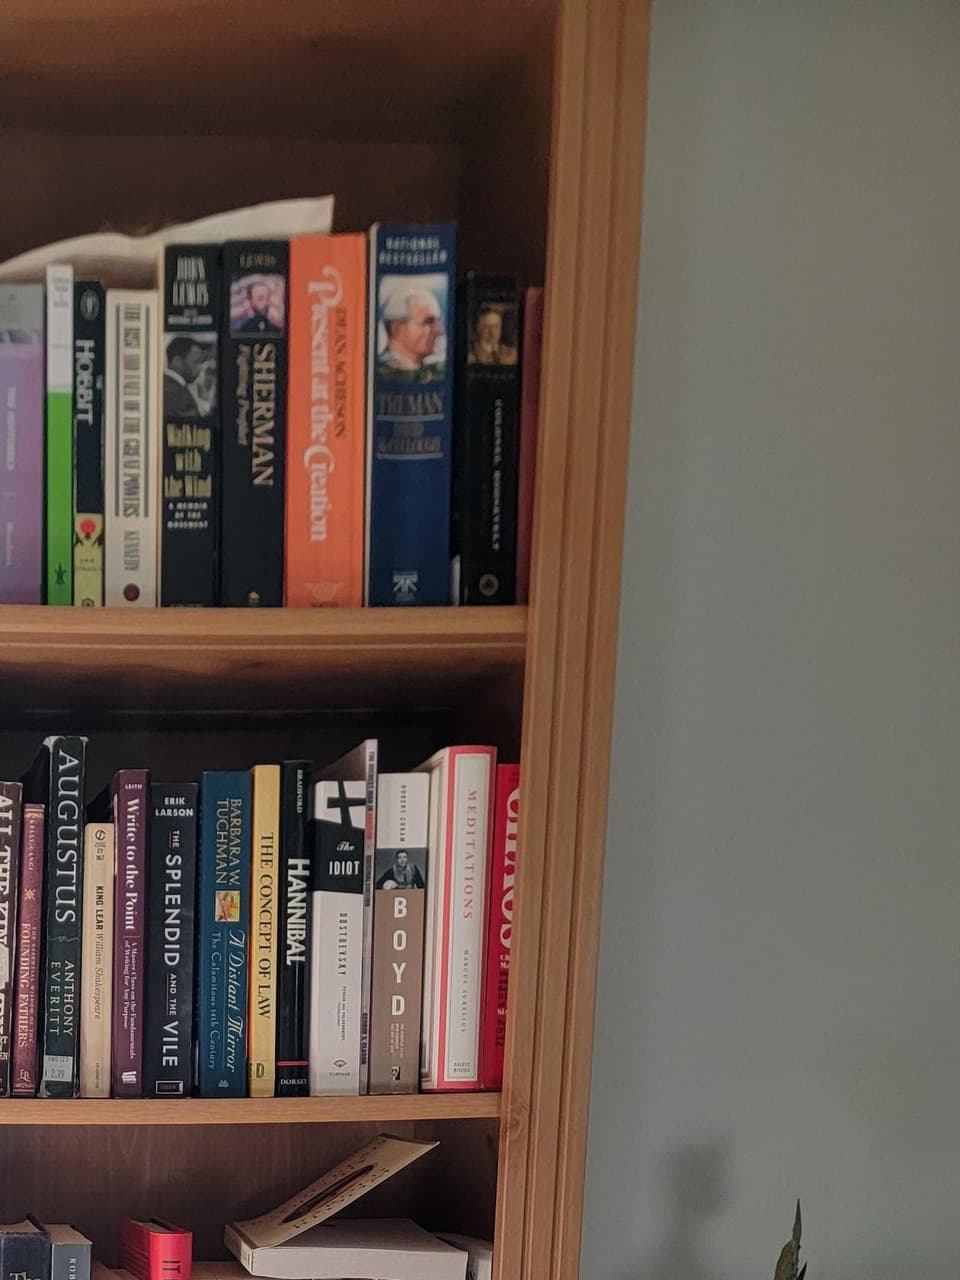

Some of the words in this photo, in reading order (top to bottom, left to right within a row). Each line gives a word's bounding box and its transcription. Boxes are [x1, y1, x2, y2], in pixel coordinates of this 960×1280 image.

[74, 339, 96, 426] HOBBIT
[251, 343, 276, 487] SHERMAN
[310, 404, 330, 440] the
[303, 445, 335, 543] Creation
[55, 748, 82, 923] AUGUSTUS
[170, 830, 180, 849] THE
[259, 831, 276, 868] THE
[336, 840, 355, 852] The
[463, 788, 478, 920] MEDITATIONS
[328, 859, 361, 876] IDIOT
[163, 853, 182, 967] SPLENDID
[258, 873, 275, 953] CONCEPT
[286, 857, 311, 966] HANNIBAL
[227, 929, 245, 947] A
[169, 972, 179, 994] AND
[226, 951, 245, 1009] Distant
[257, 958, 273, 979] OF
[48, 961, 61, 1037] EVERITT
[64, 959, 77, 1037] ANTHONY
[169, 997, 178, 1017] THE
[256, 983, 272, 1020] LAW
[161, 1020, 179, 1068] VILE
[225, 1014, 244, 1073] Mirror
[161, 1259, 182, 1275] IT
